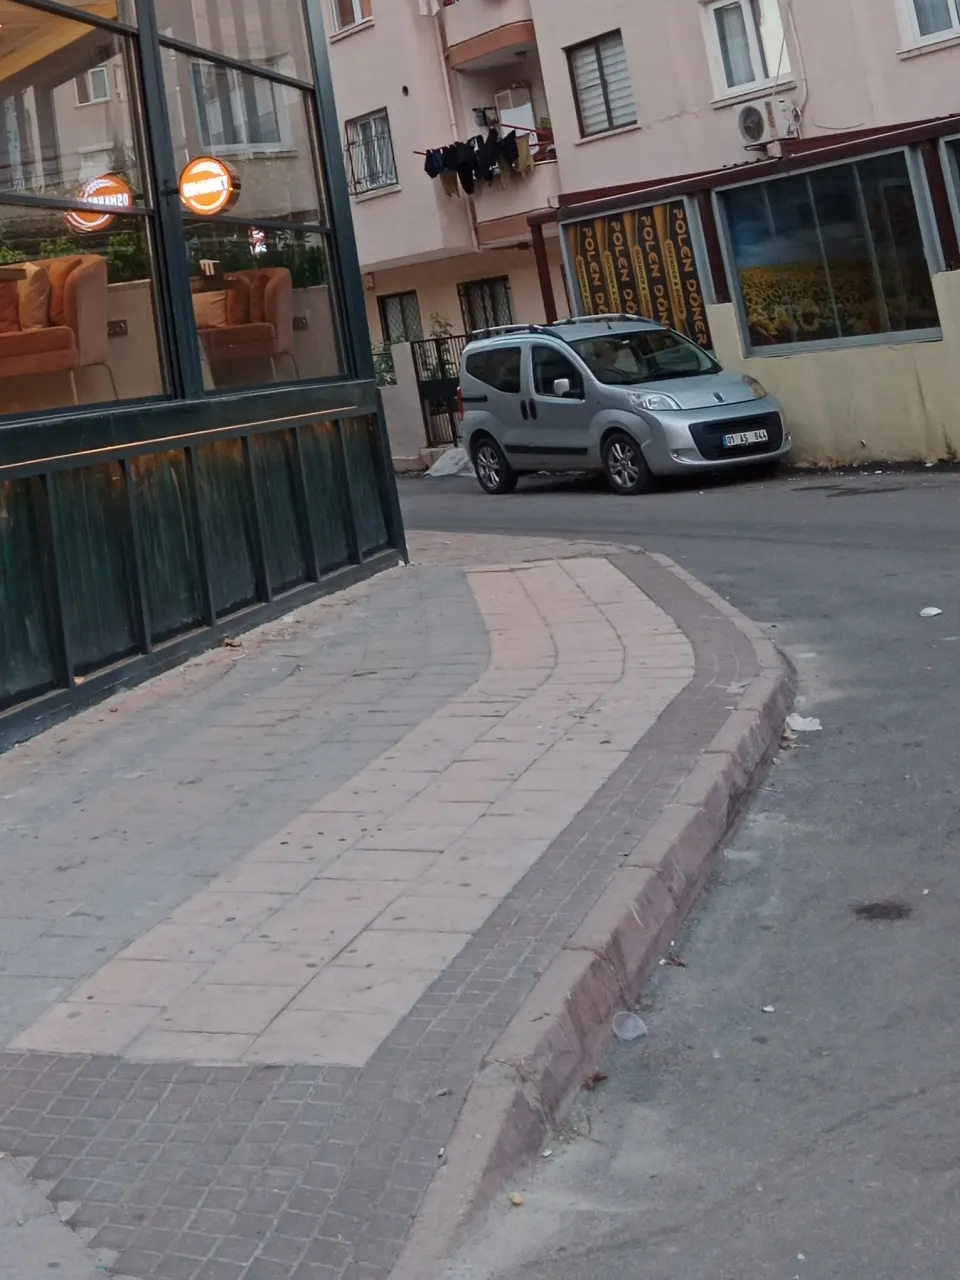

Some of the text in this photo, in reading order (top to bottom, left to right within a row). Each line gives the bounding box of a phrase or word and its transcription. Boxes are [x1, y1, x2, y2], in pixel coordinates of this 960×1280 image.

[582, 227, 602, 286] POLEN
[611, 221, 630, 281] POLEN
[641, 215, 669, 326] POLEN DÖN
[673, 208, 707, 345] POLEN DÖNER
[727, 435, 735, 444] 01
